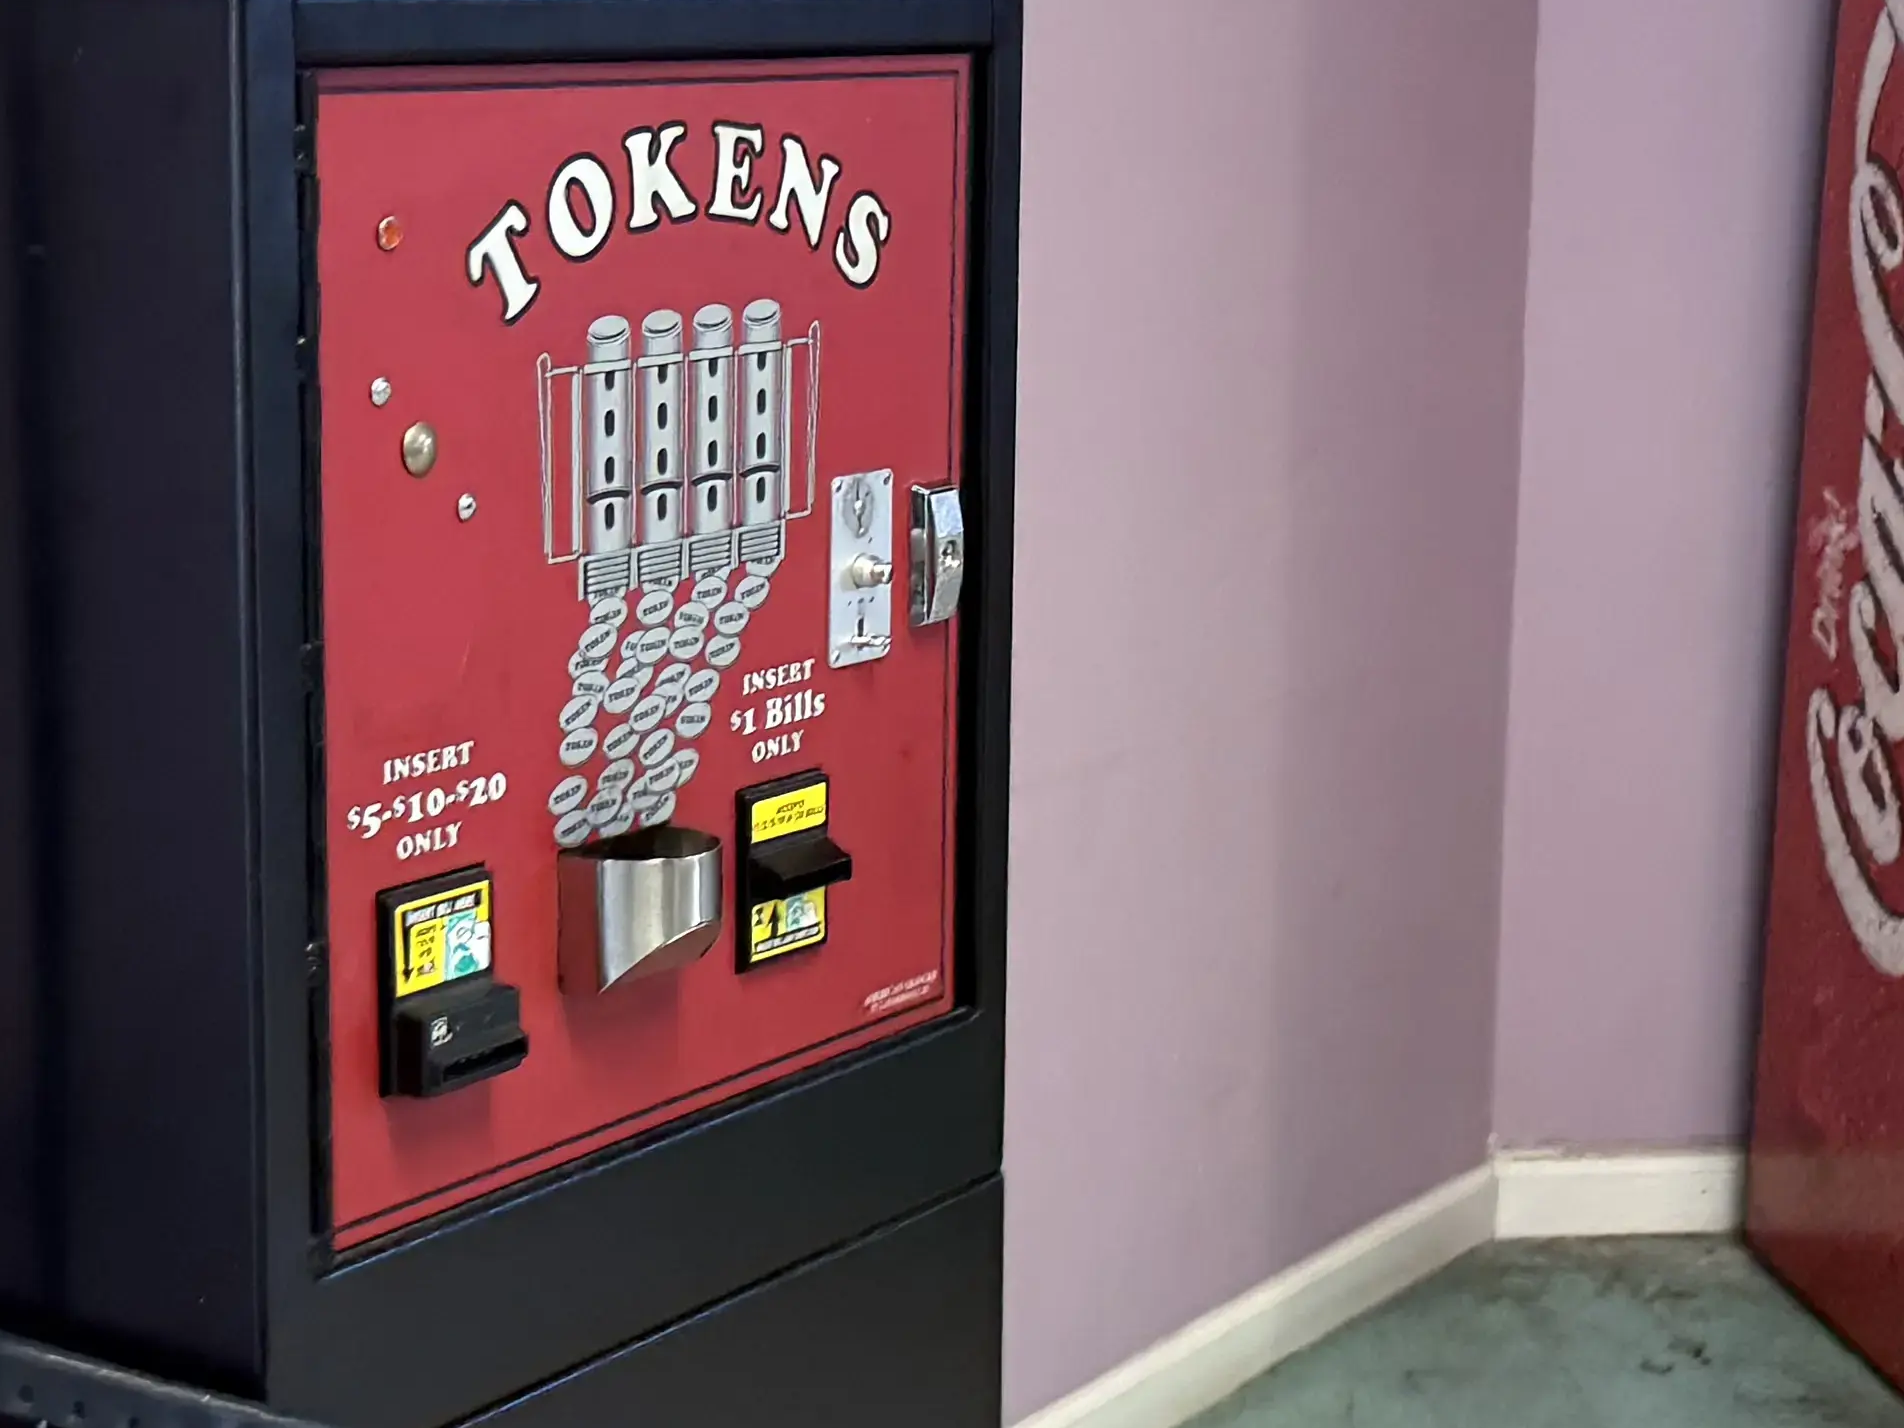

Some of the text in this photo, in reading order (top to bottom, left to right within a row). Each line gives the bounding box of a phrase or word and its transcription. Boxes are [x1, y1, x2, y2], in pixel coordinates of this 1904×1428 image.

[467, 121, 891, 324] TOKENS
[742, 658, 816, 696] INSERT
[730, 688, 826, 736] $1 Bills
[382, 740, 475, 785] INSERT
[751, 729, 805, 764] ONLY
[346, 772, 507, 840] $5-$10-$20
[396, 820, 463, 861] ONLY
